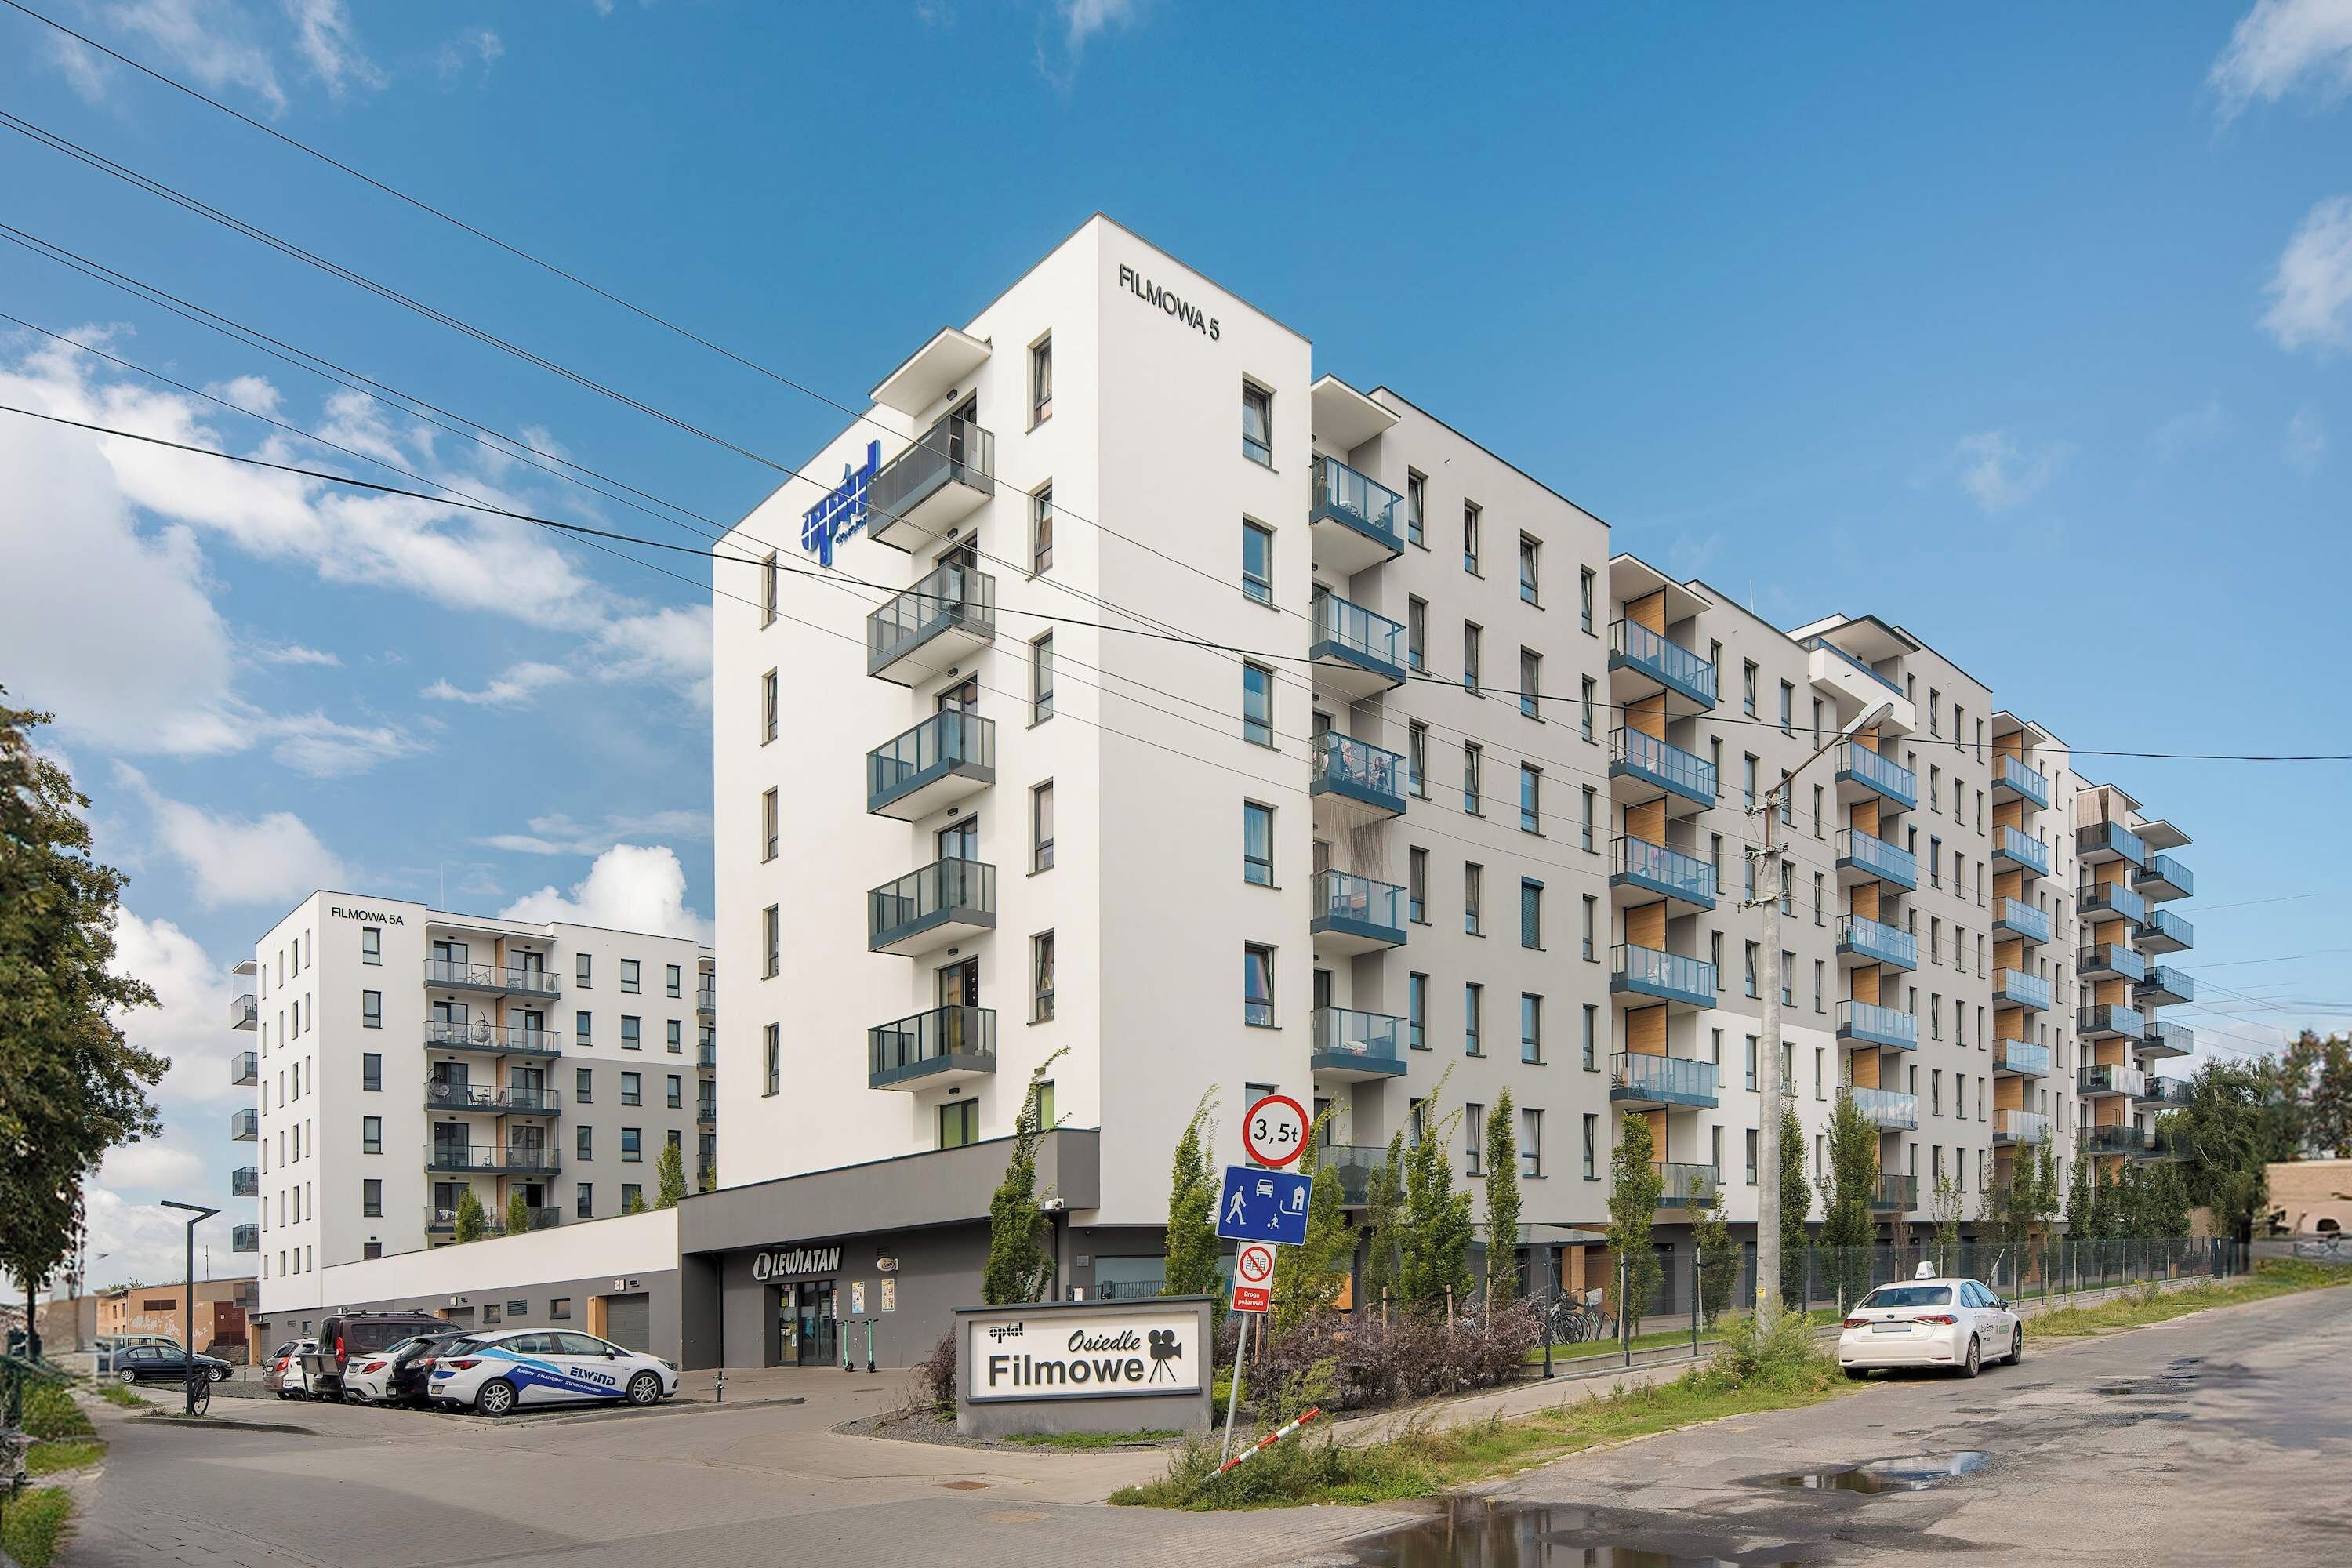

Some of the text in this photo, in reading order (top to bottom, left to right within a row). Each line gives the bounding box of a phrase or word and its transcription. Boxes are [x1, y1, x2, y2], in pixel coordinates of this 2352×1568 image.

[1120, 263, 1220, 341] FILMOWA 5
[332, 906, 404, 926] FILMOWA 5A
[771, 1247, 840, 1276] LEWIATAN
[1243, 1290, 1260, 1299] Droga
[1068, 1330, 1141, 1352] Osiedle
[989, 1354, 1144, 1387] Filmowe
